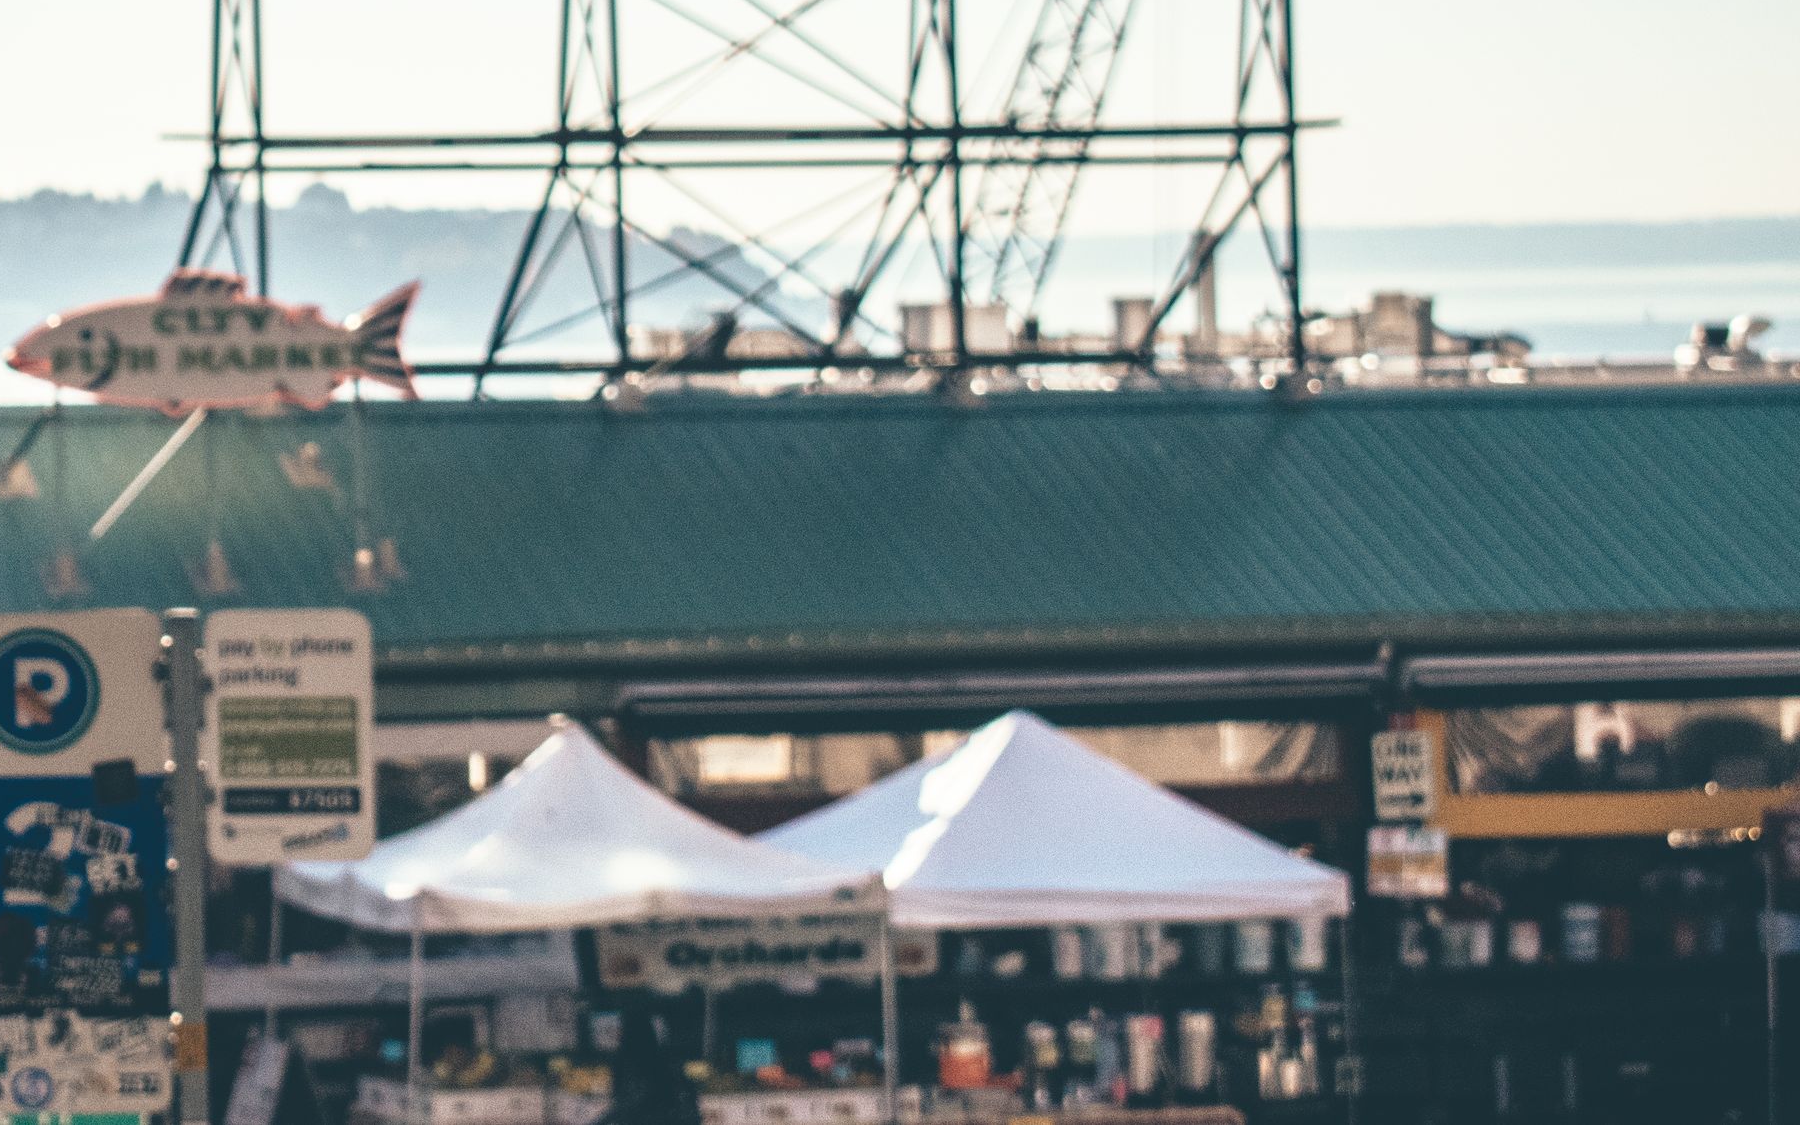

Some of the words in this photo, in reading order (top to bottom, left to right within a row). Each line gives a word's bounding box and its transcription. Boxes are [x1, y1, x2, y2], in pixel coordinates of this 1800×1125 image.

[153, 307, 273, 335] CITY
[218, 639, 254, 658] pay
[290, 635, 353, 658] phone
[220, 664, 297, 686] parking
[14, 657, 69, 728] P
